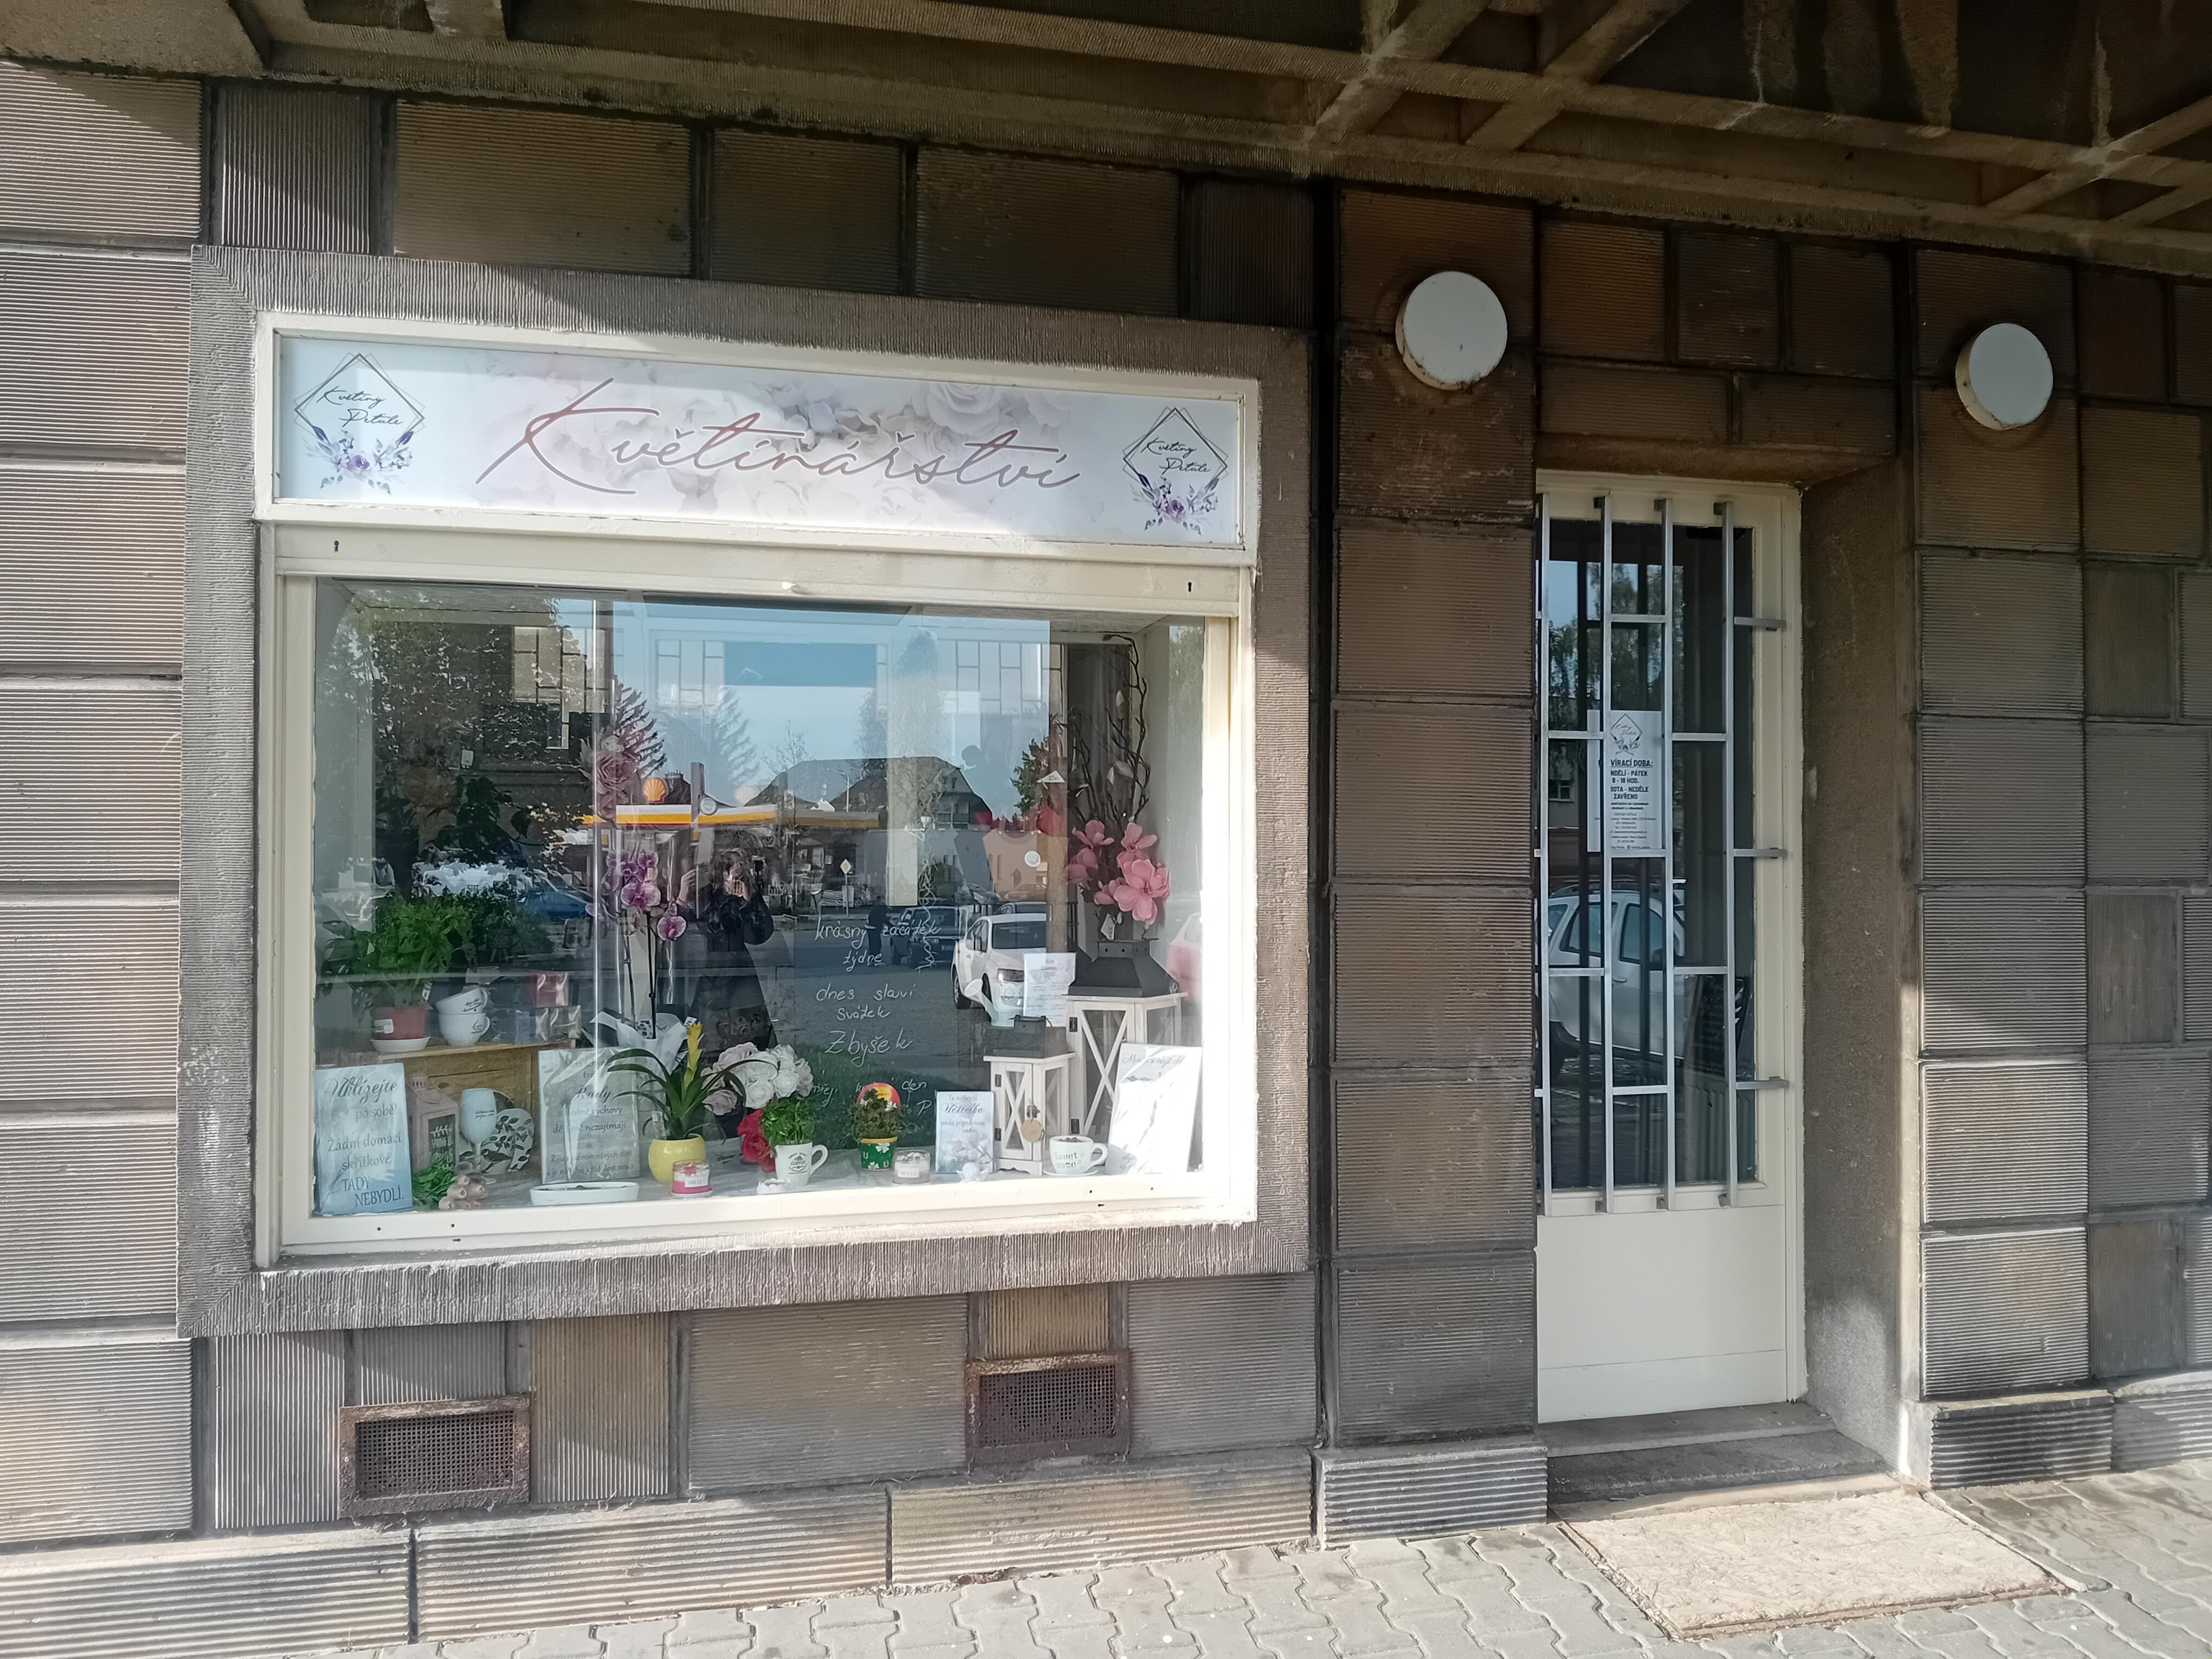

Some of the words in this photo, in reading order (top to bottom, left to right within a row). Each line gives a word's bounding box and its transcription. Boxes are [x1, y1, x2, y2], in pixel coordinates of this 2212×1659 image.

[475, 378, 1080, 494] Květinářství
[816, 983, 854, 1001] dnes
[825, 1028, 913, 1067] Zbyšek
[901, 1078, 927, 1091] den
[355, 1109, 369, 1123] po
[372, 1103, 398, 1118] sobě!
[363, 1131, 402, 1147] domácí
[342, 1176, 371, 1192] TADY
[354, 1185, 404, 1207] NEBYDLÍ.
